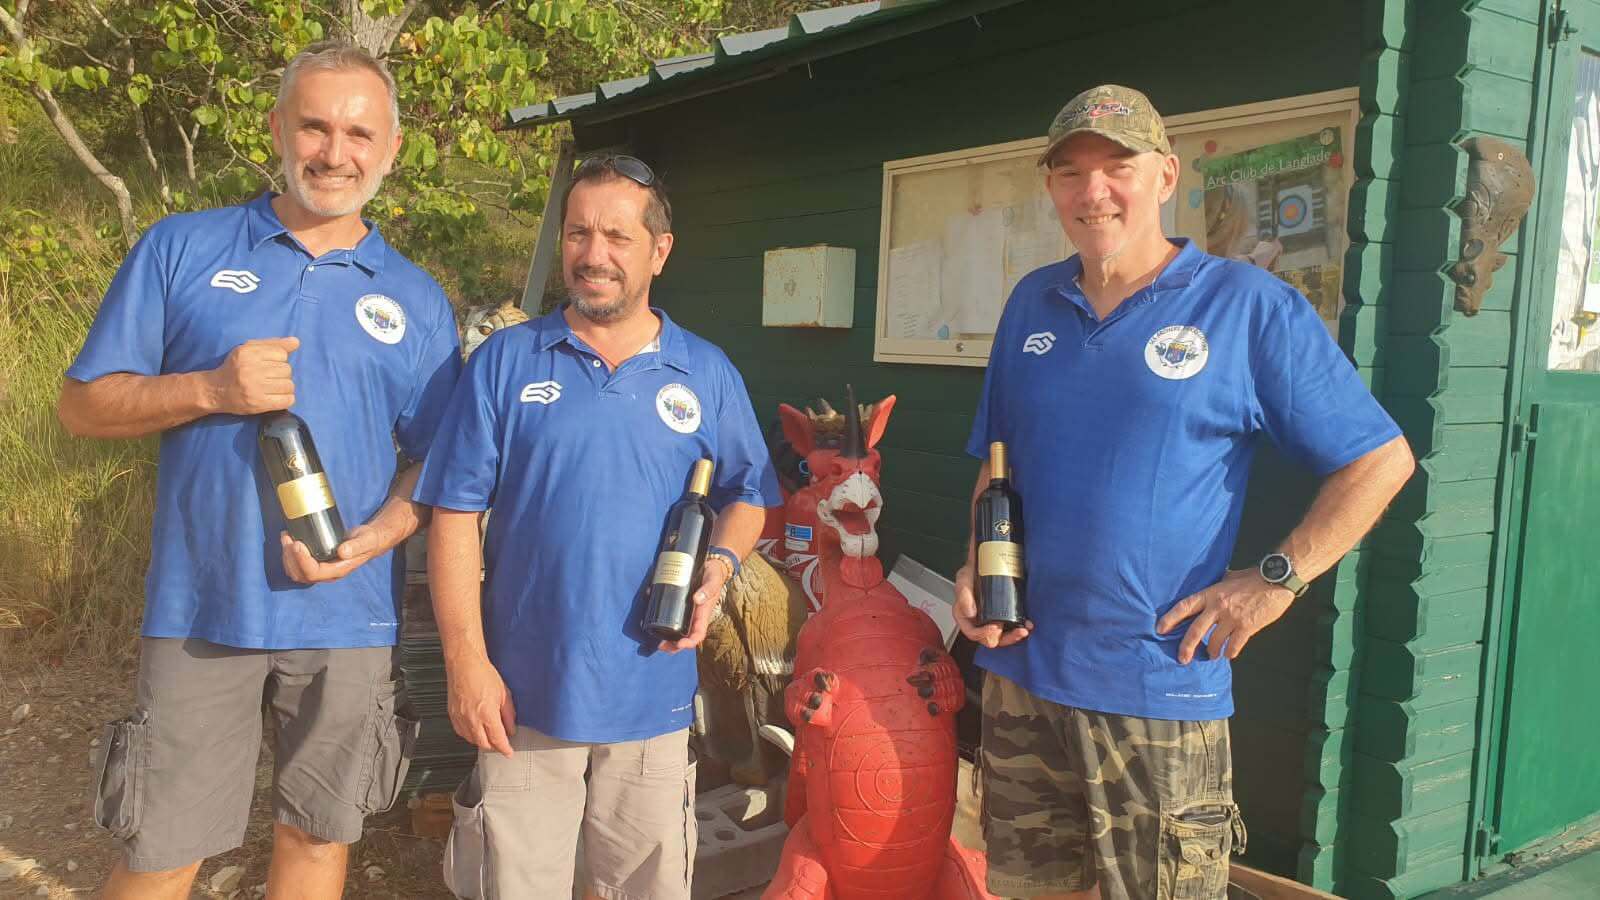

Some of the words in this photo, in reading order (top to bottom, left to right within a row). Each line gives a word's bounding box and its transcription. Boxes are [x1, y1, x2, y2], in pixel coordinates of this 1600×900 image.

[1207, 175, 1226, 188] Arc
[1230, 167, 1257, 181] Club
[1262, 163, 1275, 175] de
[1279, 149, 1331, 170] Langlade
